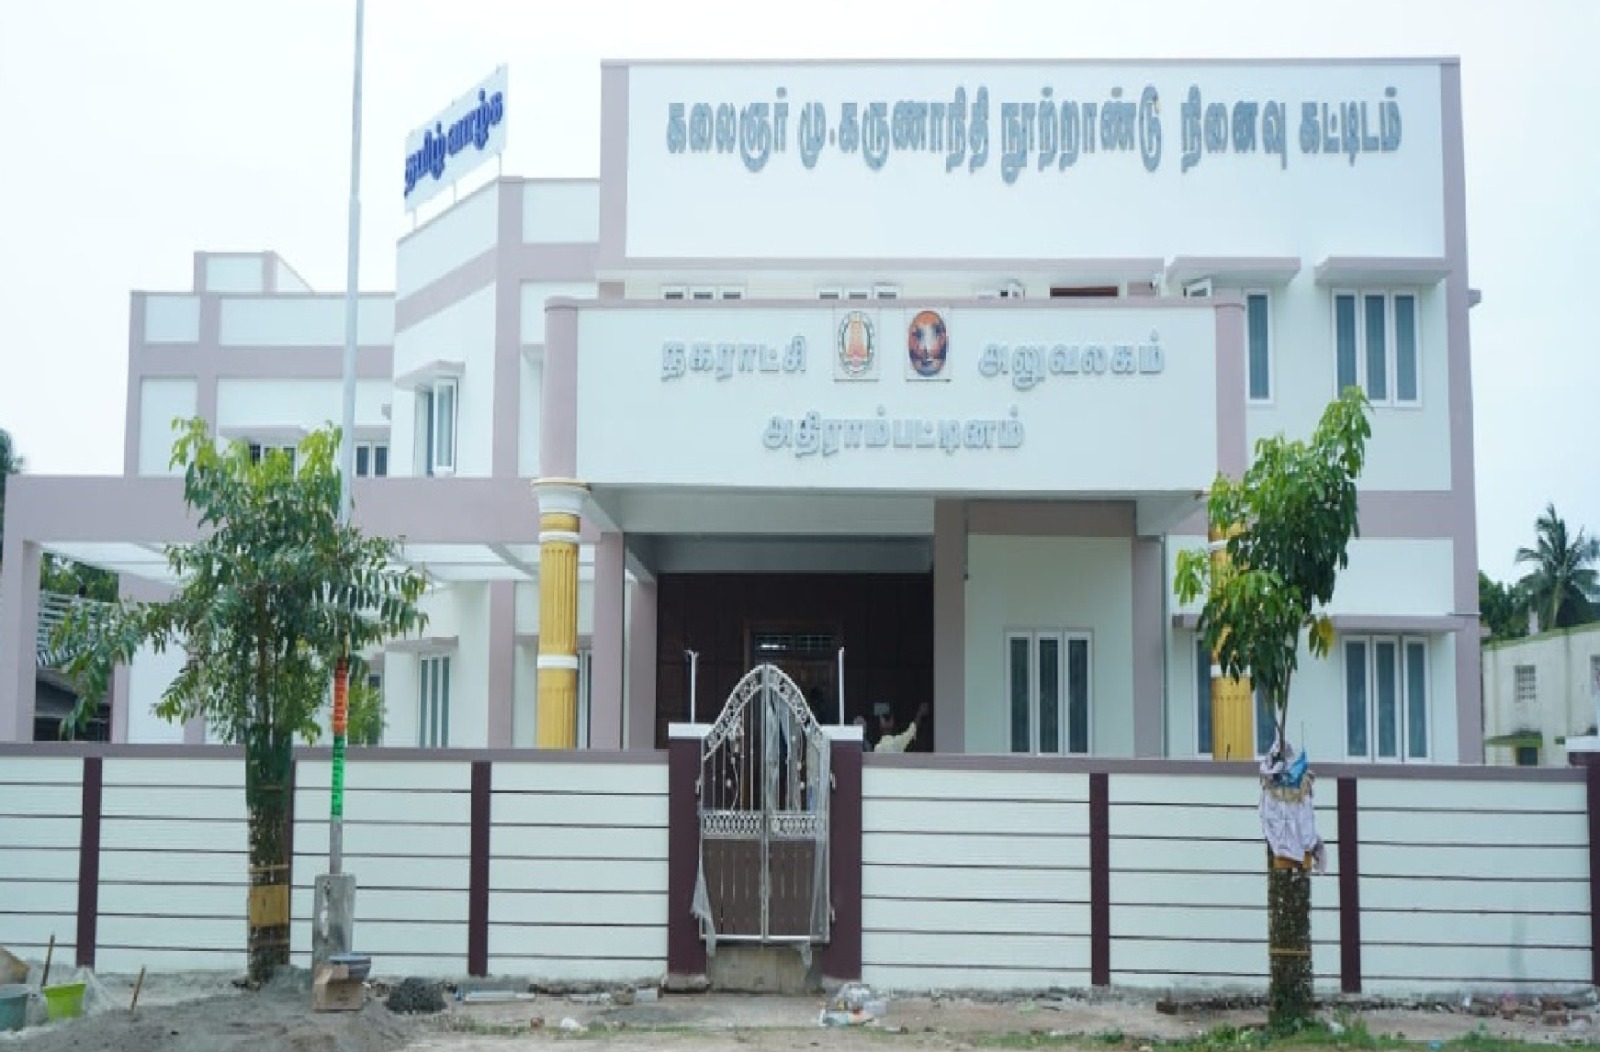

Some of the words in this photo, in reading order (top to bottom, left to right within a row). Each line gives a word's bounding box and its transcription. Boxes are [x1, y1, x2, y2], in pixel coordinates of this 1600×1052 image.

[666, 86, 789, 173] கலைஞர்
[1001, 85, 1162, 185] நூற்றாண்டு
[1181, 85, 1288, 174] நினைவு
[1300, 86, 1403, 167] கட்டிடம்
[660, 335, 807, 383] நகராட்சி
[978, 330, 1166, 394] அலுவலகம்
[762, 406, 1026, 459] அதிராம்பட்டினம்
